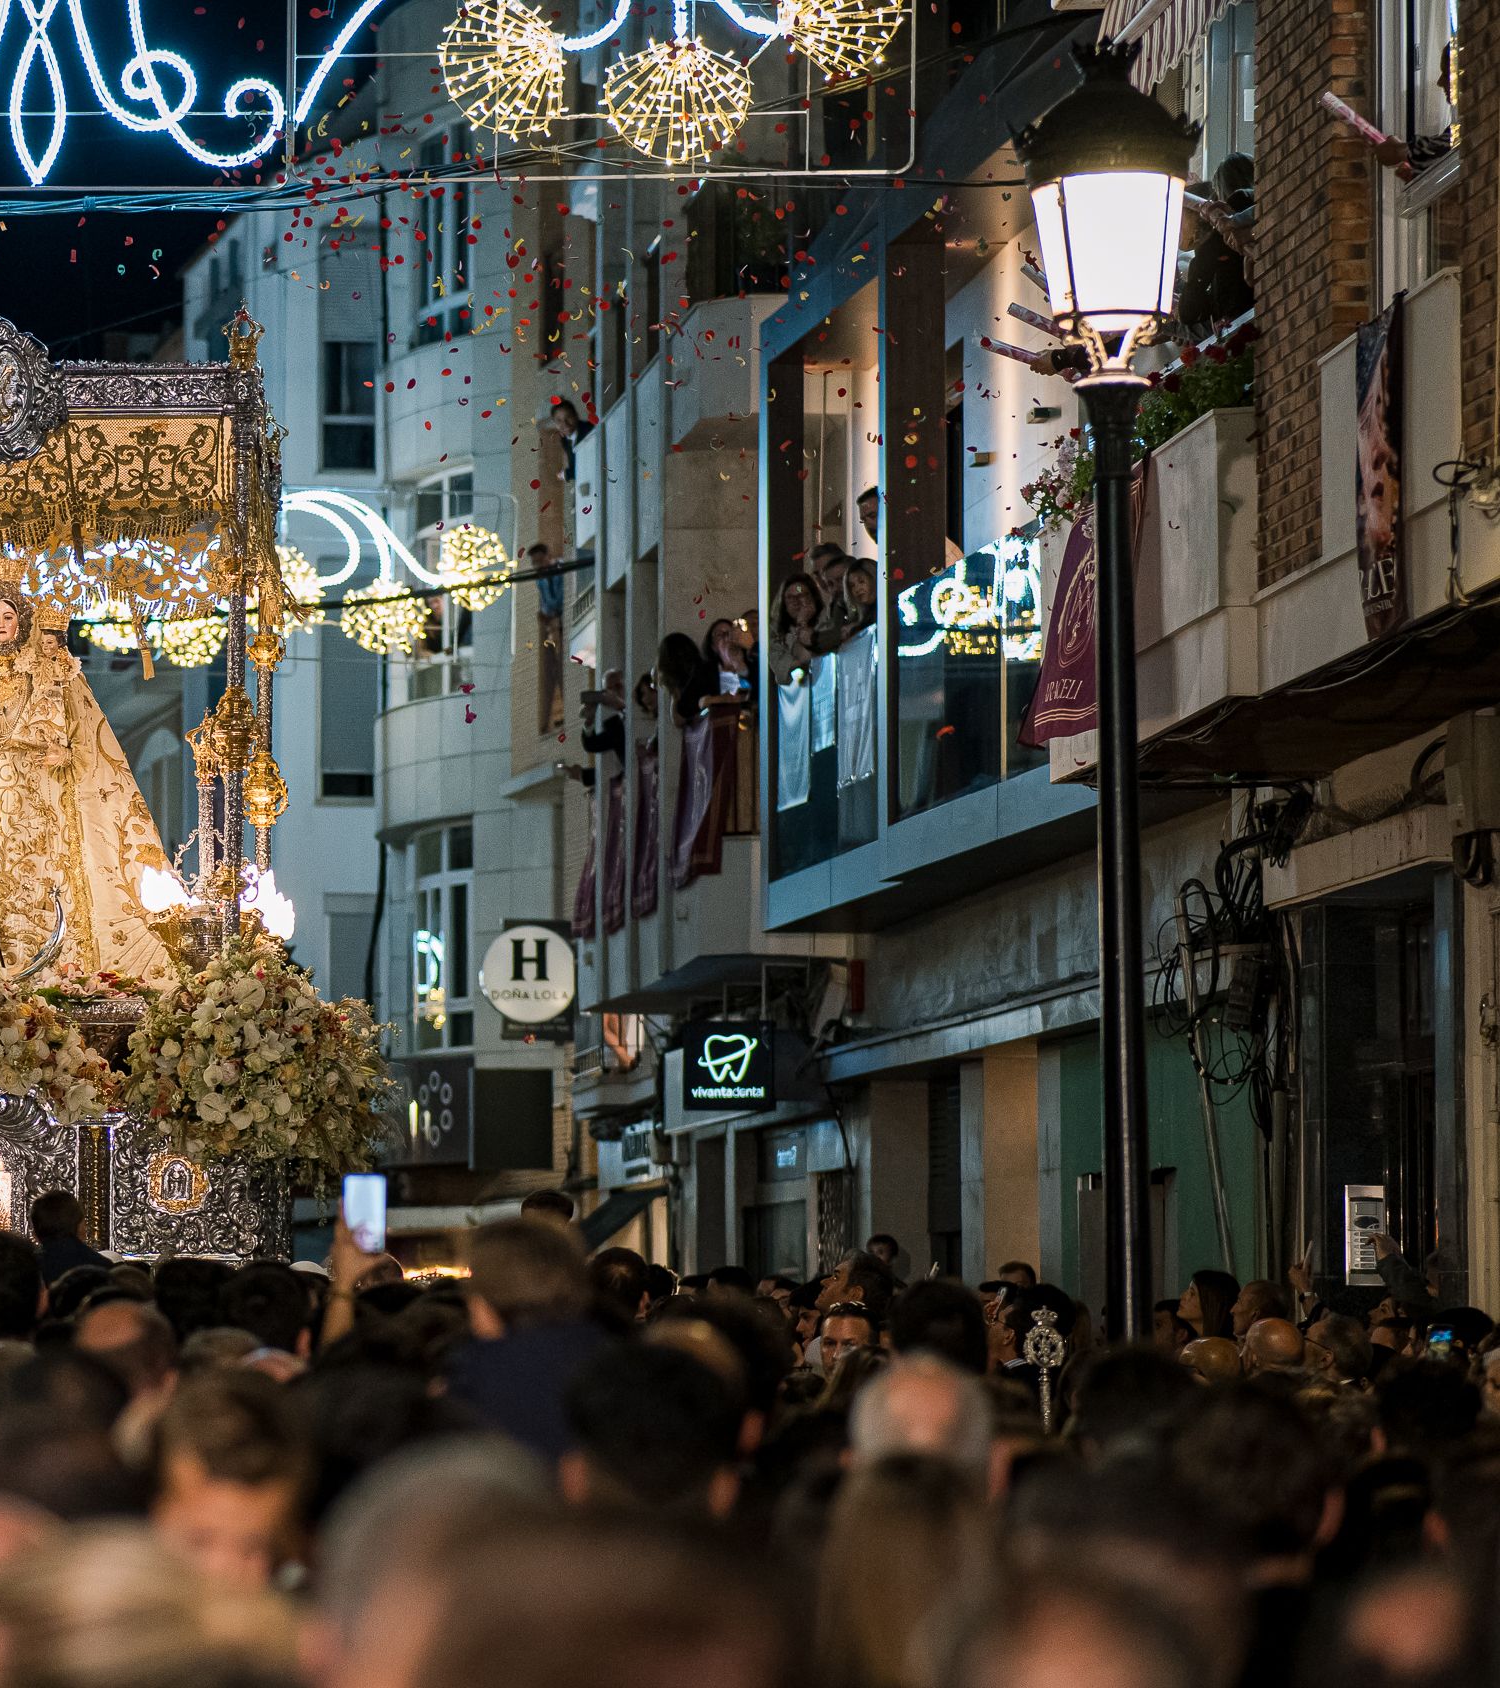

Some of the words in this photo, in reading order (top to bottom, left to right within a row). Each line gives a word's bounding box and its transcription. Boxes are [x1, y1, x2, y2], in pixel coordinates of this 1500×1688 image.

[510, 938, 549, 981] H
[491, 988, 529, 1000] DOÑA
[534, 990, 569, 1000] LOLA
[691, 1086, 765, 1098] vivantadental
